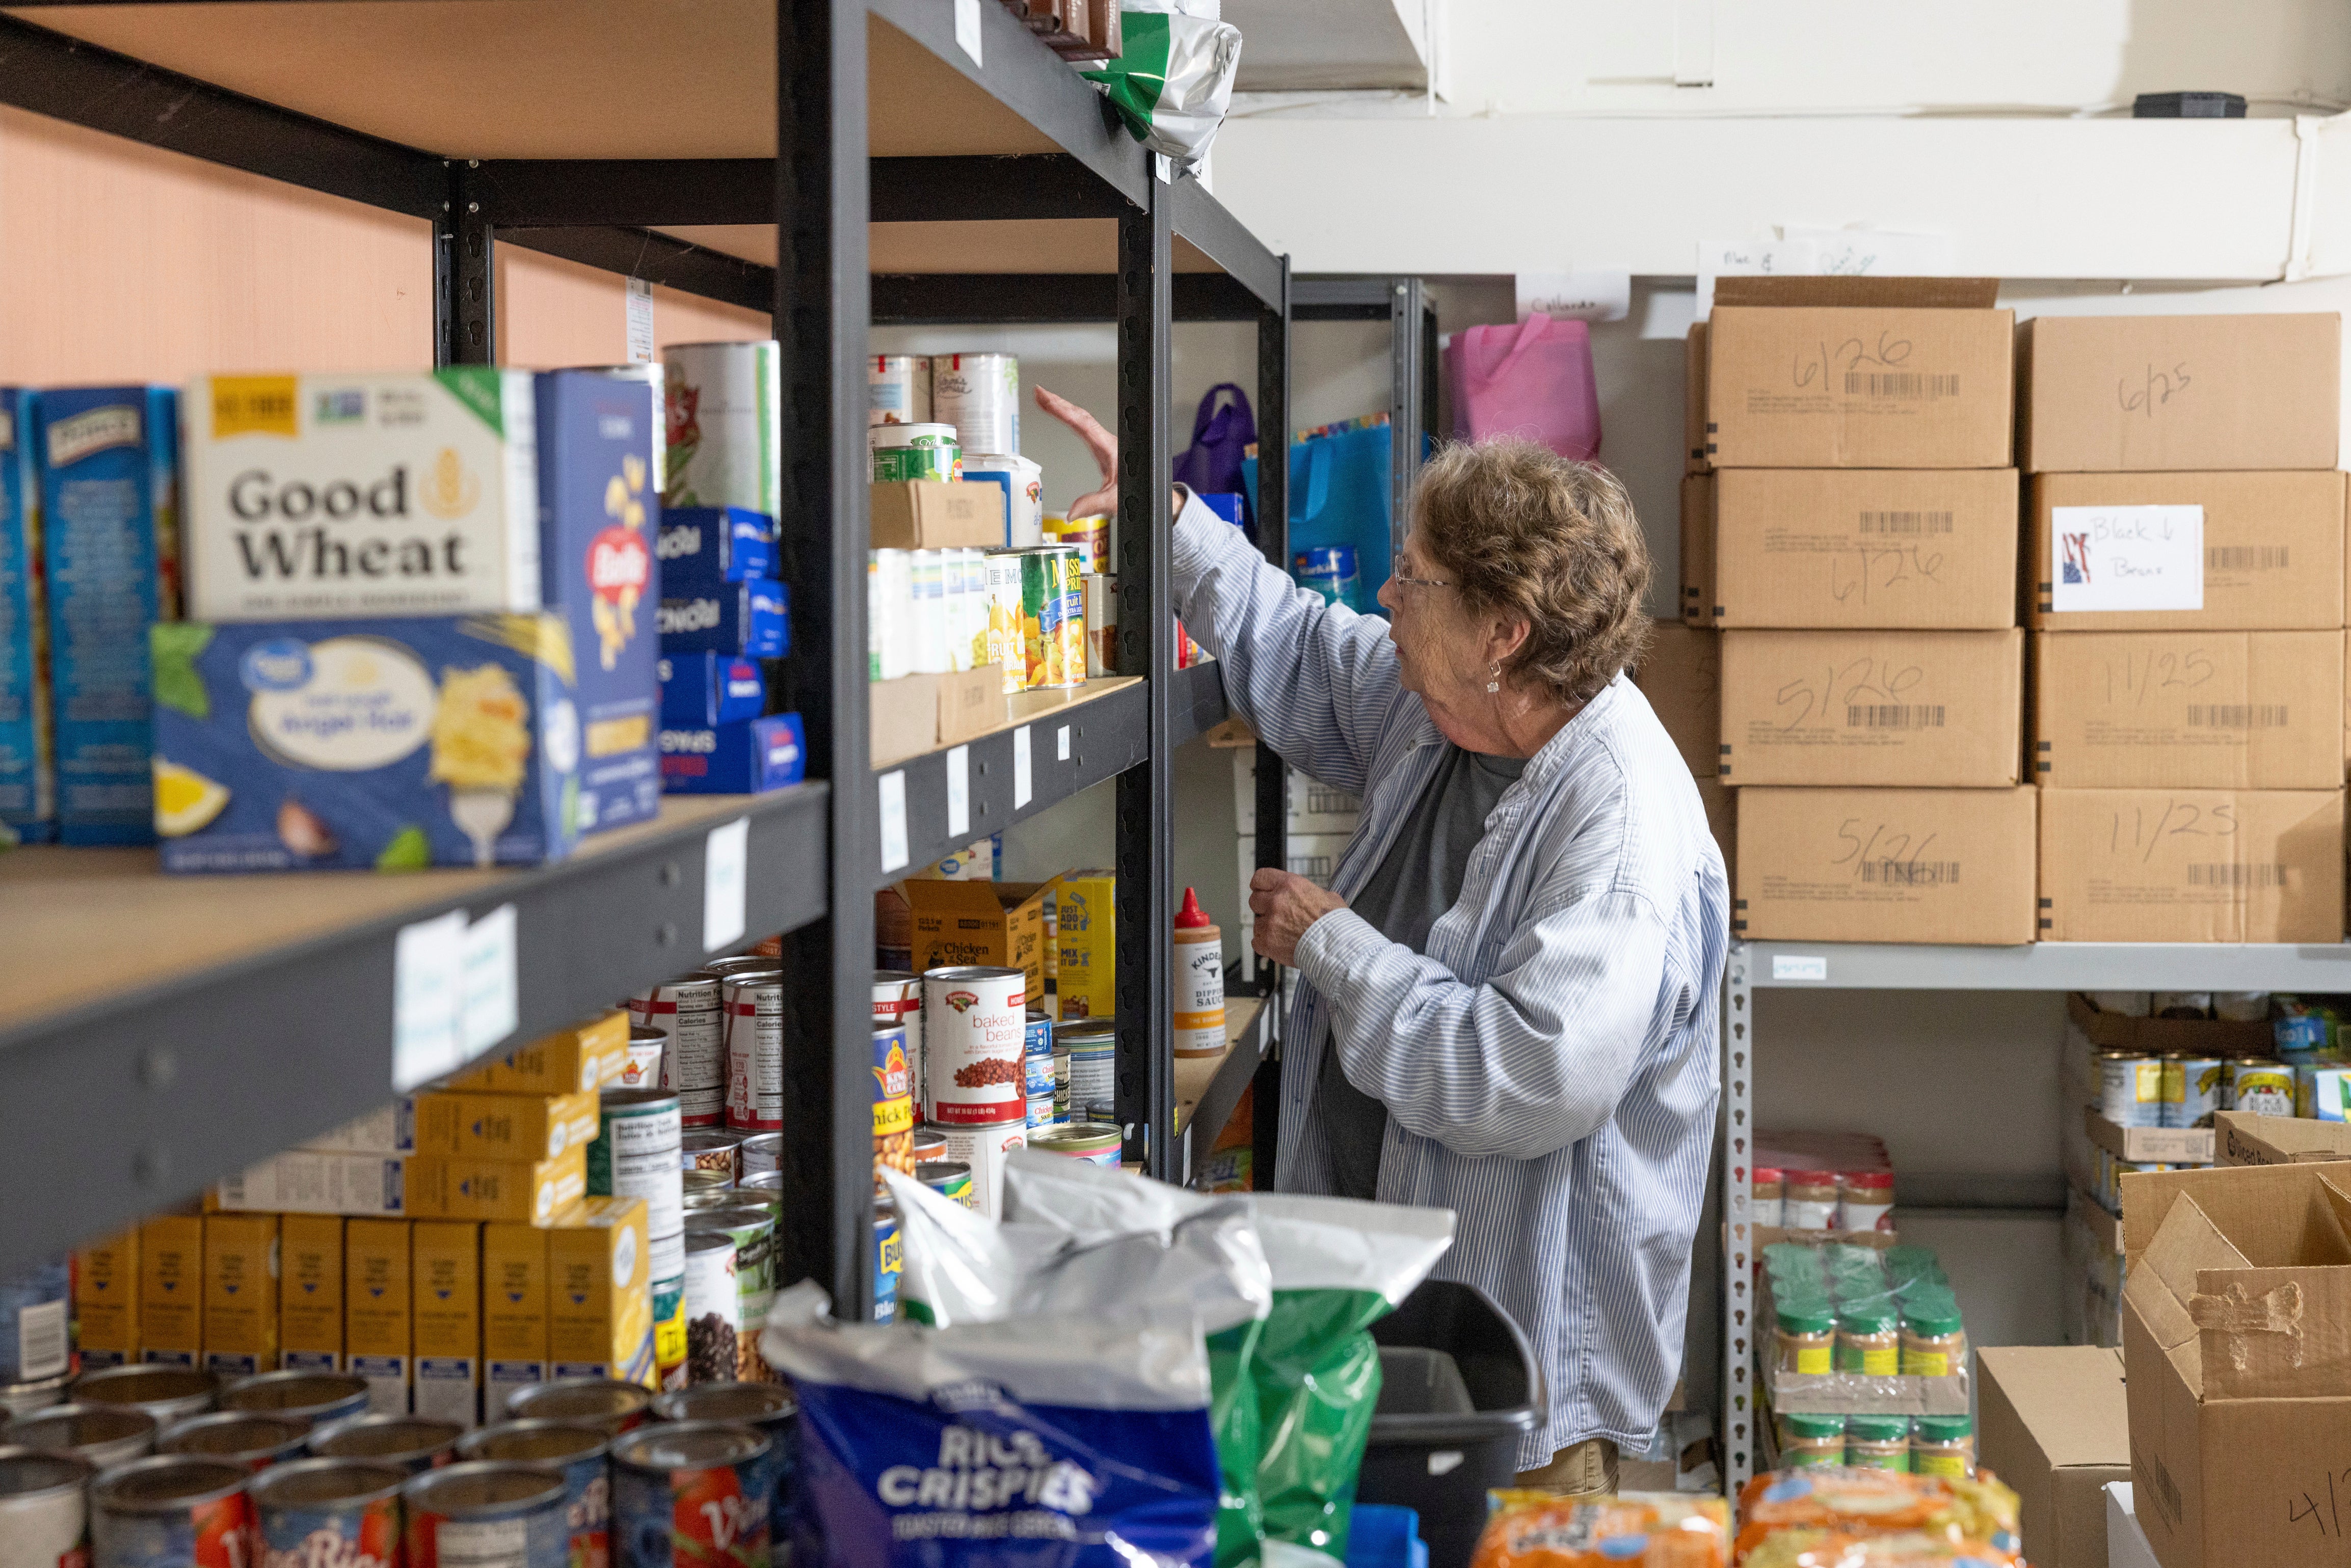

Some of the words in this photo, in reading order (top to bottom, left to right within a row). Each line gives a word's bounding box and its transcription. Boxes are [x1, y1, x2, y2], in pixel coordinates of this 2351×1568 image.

[230, 466, 408, 522] Good
[2092, 517, 2151, 542] Black
[235, 526, 466, 580] Wheat
[1051, 558, 1081, 588] MISSI
[659, 729, 716, 753] SPAG
[2112, 798, 2239, 863] 11/25
[944, 942, 990, 957] Chicken
[955, 954, 977, 965] Sea
[678, 990, 711, 999] Nutrition
[1195, 987, 1223, 998] DIPPIN
[1196, 995, 1224, 1007] SAUC
[872, 1003, 895, 1013] STYLE
[973, 1012, 1014, 1029] baked
[986, 1027, 1021, 1042] beans
[1053, 1089, 1071, 1102] CHICKE
[877, 1461, 1093, 1515] CRISPIES
[2289, 1467, 2351, 1537] 4/
